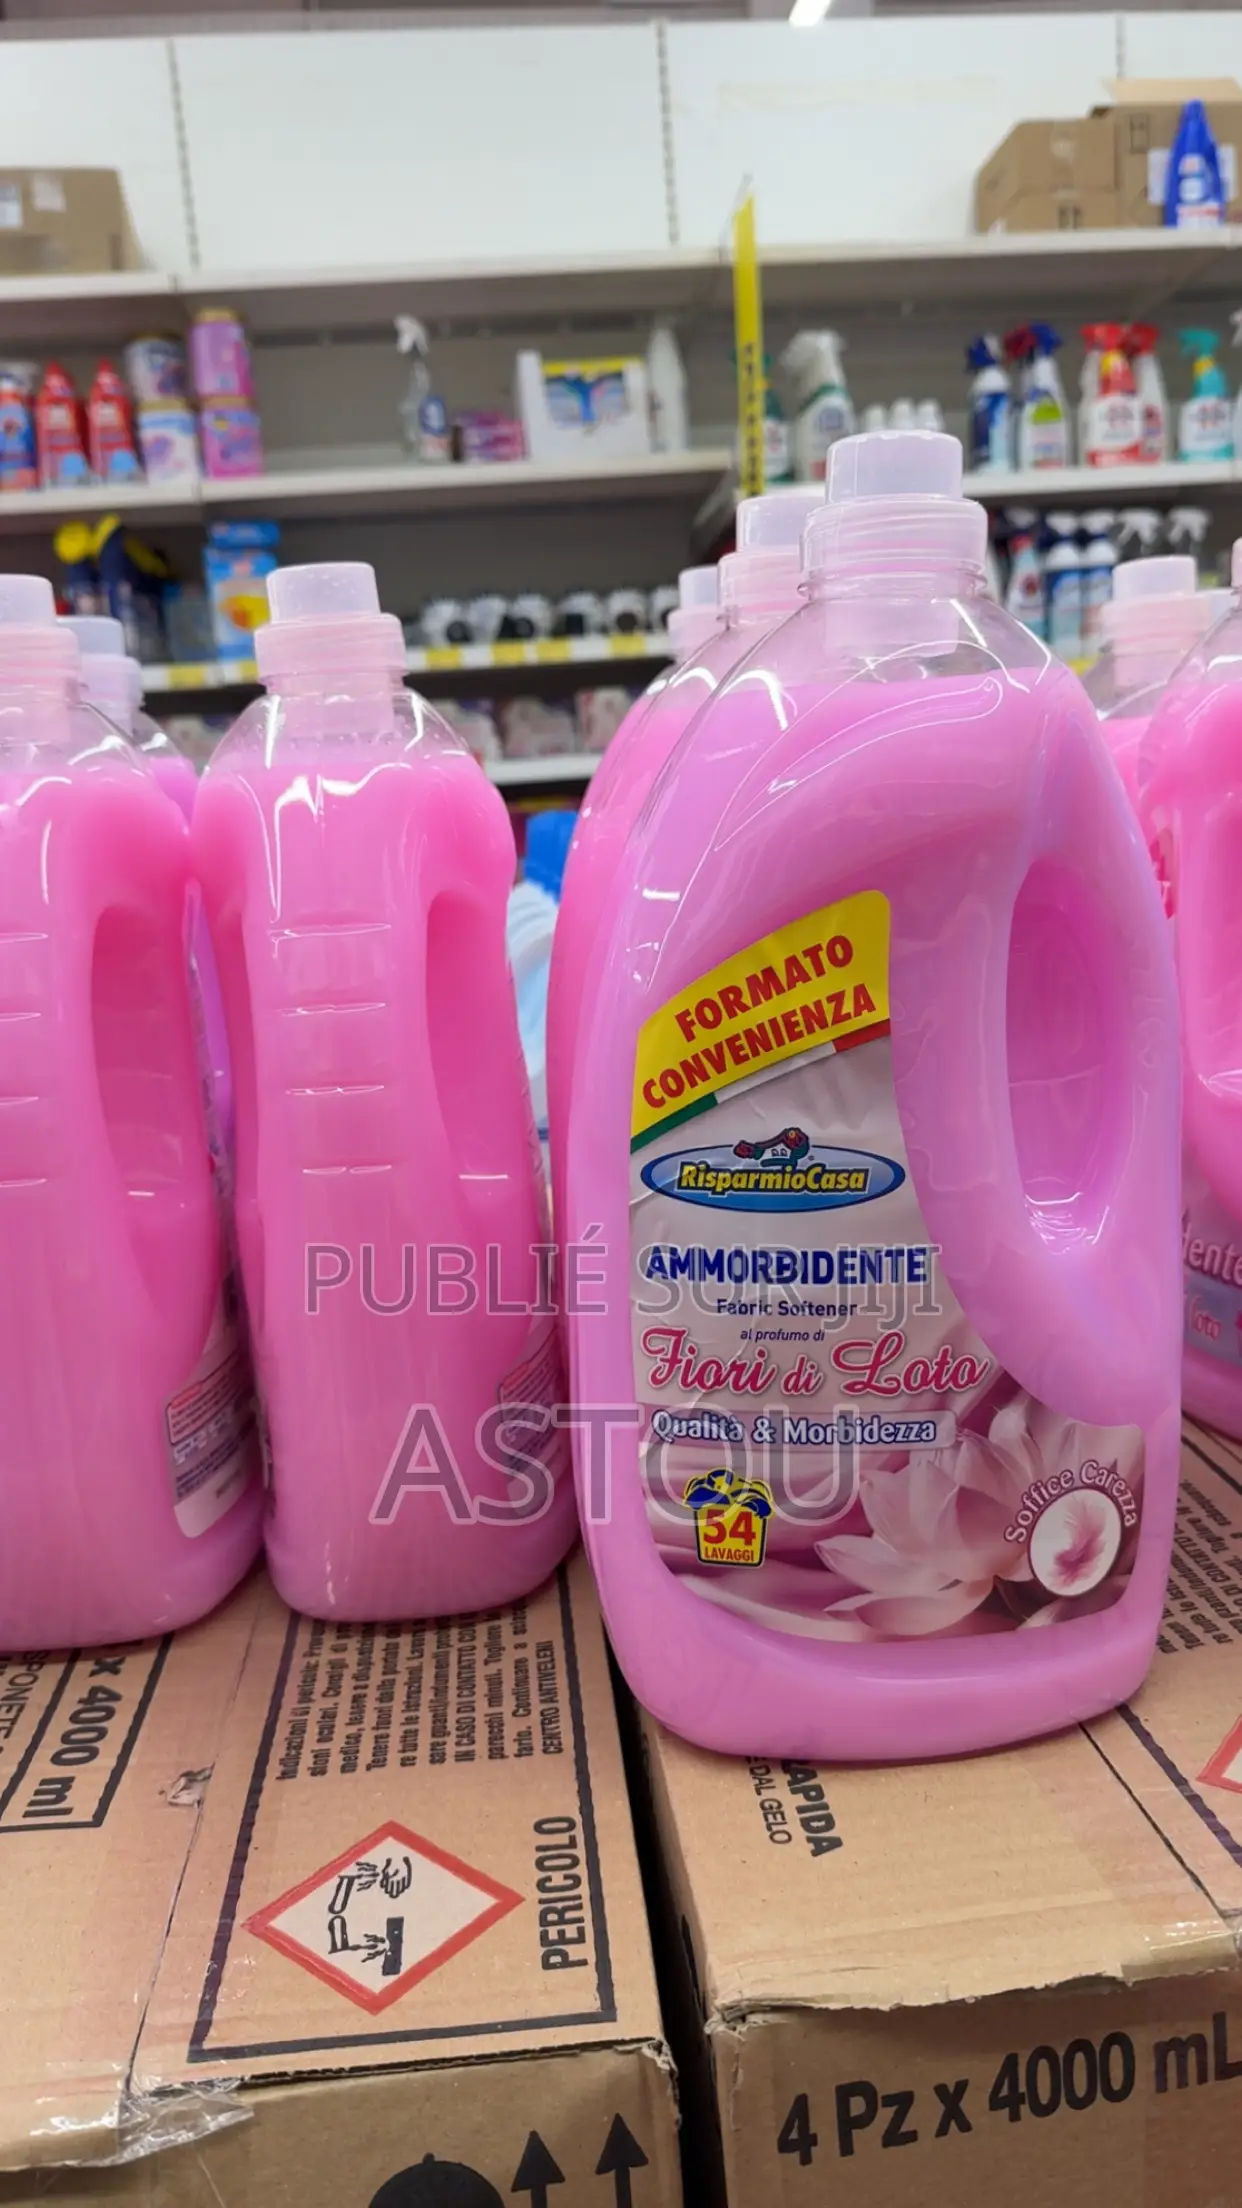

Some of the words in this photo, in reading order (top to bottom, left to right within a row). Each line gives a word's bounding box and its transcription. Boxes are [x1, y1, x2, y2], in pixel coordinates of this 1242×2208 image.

[674, 934, 854, 1044] FORMATO
[642, 982, 877, 1109] CONVENIENZA
[677, 1160, 869, 1195] RisparmioCasa
[646, 1245, 929, 1286] AMMORBIDENTE
[716, 1298, 773, 1317] Fabric
[777, 1299, 859, 1317] Softener
[740, 1328, 752, 1341] al
[755, 1328, 809, 1344] profumo
[813, 1327, 826, 1341] di
[641, 1325, 777, 1396] Fiori
[782, 1354, 824, 1396] di
[832, 1330, 991, 1397] Loto
[651, 1408, 744, 1443] Qualità
[752, 1414, 776, 1443] &
[782, 1414, 937, 1446] Morbidezza
[1004, 1468, 1074, 1543] Soffice
[1080, 1459, 1138, 1527] Carezza
[703, 1508, 757, 1547] 54
[704, 1546, 755, 1562] LAVAGGI
[88, 1656, 127, 1678] x
[456, 1645, 477, 1698] CONTATTO
[512, 1657, 531, 1717] Continuare
[535, 1641, 560, 1703] ANTIVELENI
[49, 1684, 124, 1767] 4000
[456, 1700, 476, 1714] DI
[455, 1716, 476, 1746] CASO
[484, 1711, 509, 1759] parecchi
[540, 1706, 564, 1755] CENTRO
[365, 1733, 390, 1771] Tenere
[454, 1749, 476, 1762] IN
[22, 1776, 76, 1818] ml
[749, 1765, 776, 1796] DAL
[759, 1798, 792, 1844] GELO
[533, 1816, 589, 1971] PERICOLO
[777, 2093, 819, 2167] 4
[835, 2080, 919, 2158] Pz
[932, 2078, 974, 2139] x
[988, 2030, 1136, 2123] 4000
[1154, 2011, 1242, 2095] mL
